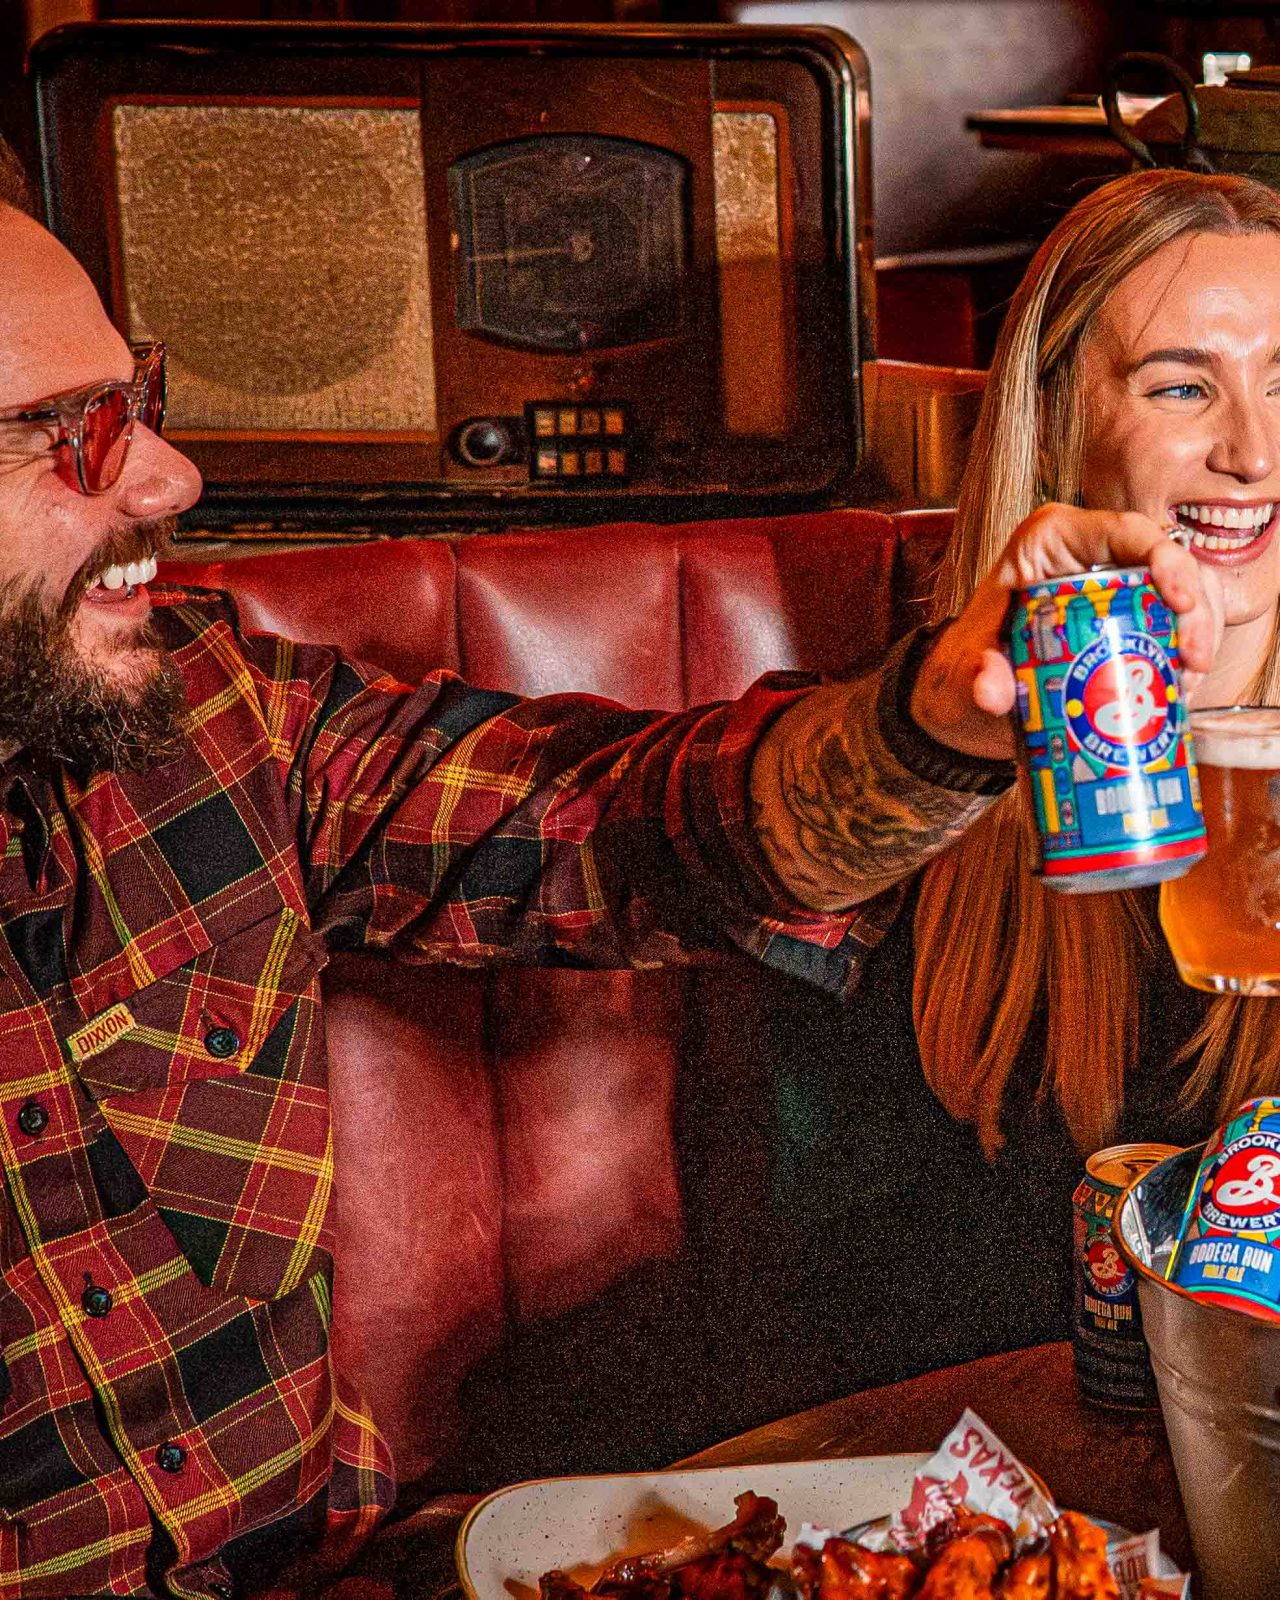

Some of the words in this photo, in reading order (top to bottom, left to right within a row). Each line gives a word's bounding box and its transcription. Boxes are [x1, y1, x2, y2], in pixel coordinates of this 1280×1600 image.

[1072, 634, 1168, 682] BROKLYN
[1083, 720, 1176, 761] BREERY
[76, 1010, 129, 1054] DIXXON
[1189, 1242, 1240, 1264] BODEGA
[1241, 1245, 1273, 1274] RUN
[949, 1427, 1034, 1509] TEXAS
